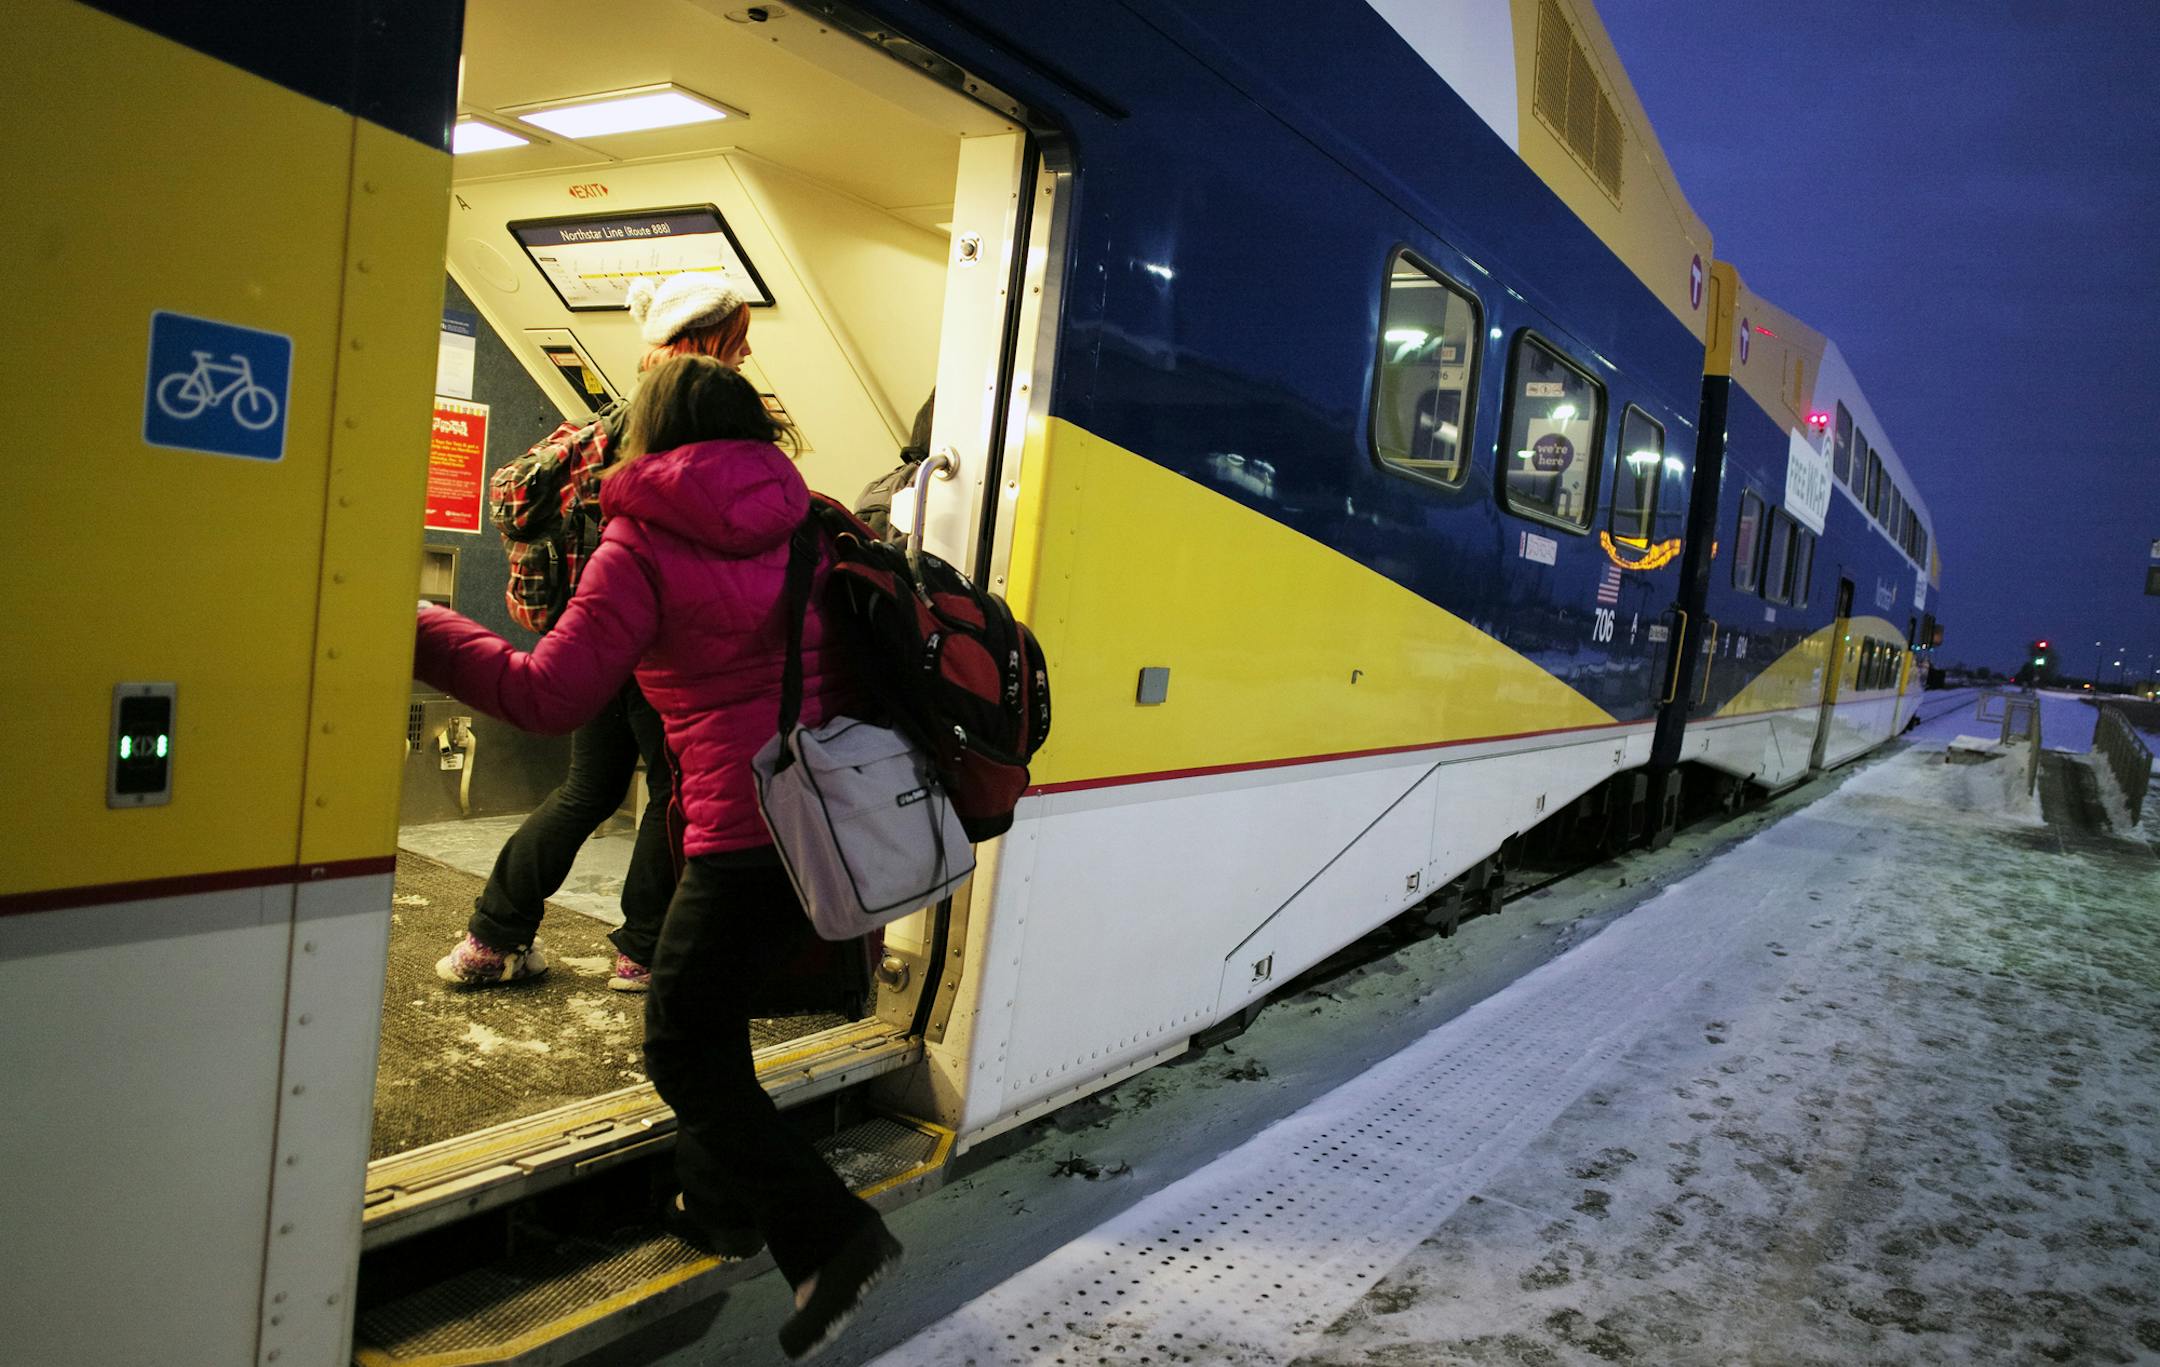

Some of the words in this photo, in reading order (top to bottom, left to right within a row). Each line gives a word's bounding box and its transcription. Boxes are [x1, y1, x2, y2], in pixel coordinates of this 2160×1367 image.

[572, 183, 603, 199] EXIT
[455, 194, 472, 211] A
[559, 228, 602, 241] Northstar
[602, 226, 625, 239] Line
[623, 225, 651, 237] (Route
[651, 221, 671, 235] 888)
[1537, 443, 1569, 455] we're
[1538, 454, 1565, 467] here
[1787, 453, 1807, 501] FREE
[1592, 607, 1616, 642] 706
